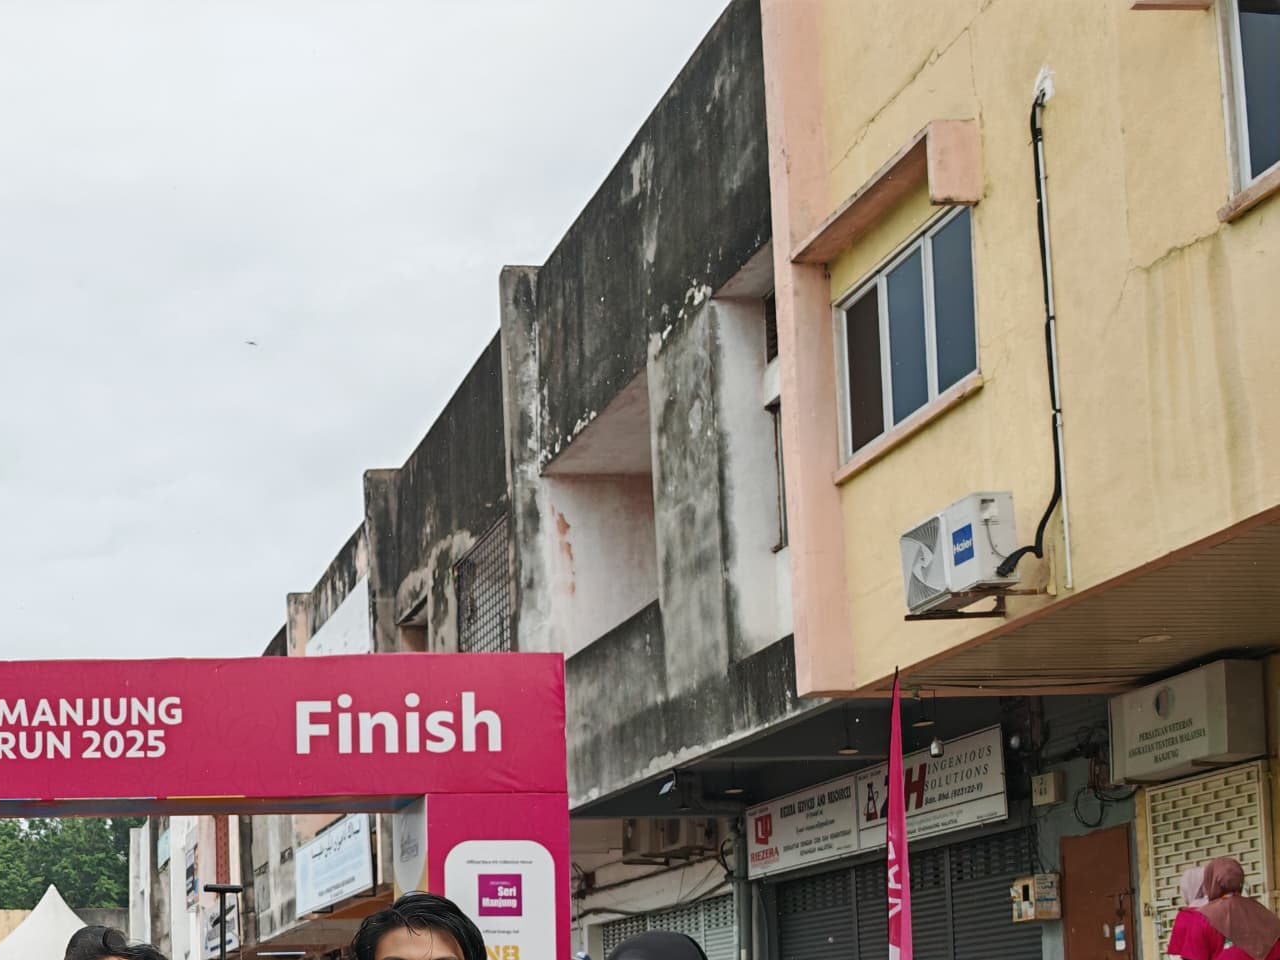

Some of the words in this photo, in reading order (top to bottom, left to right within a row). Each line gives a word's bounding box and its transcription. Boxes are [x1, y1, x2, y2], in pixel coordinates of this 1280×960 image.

[953, 538, 973, 553] Haier
[295, 691, 503, 755] Finish
[81, 729, 166, 758] 2025
[927, 745, 993, 775] INGENIOUS
[924, 763, 990, 792] SOLUTIONS
[482, 897, 517, 909] Manjung
[497, 886, 517, 897] Seri
